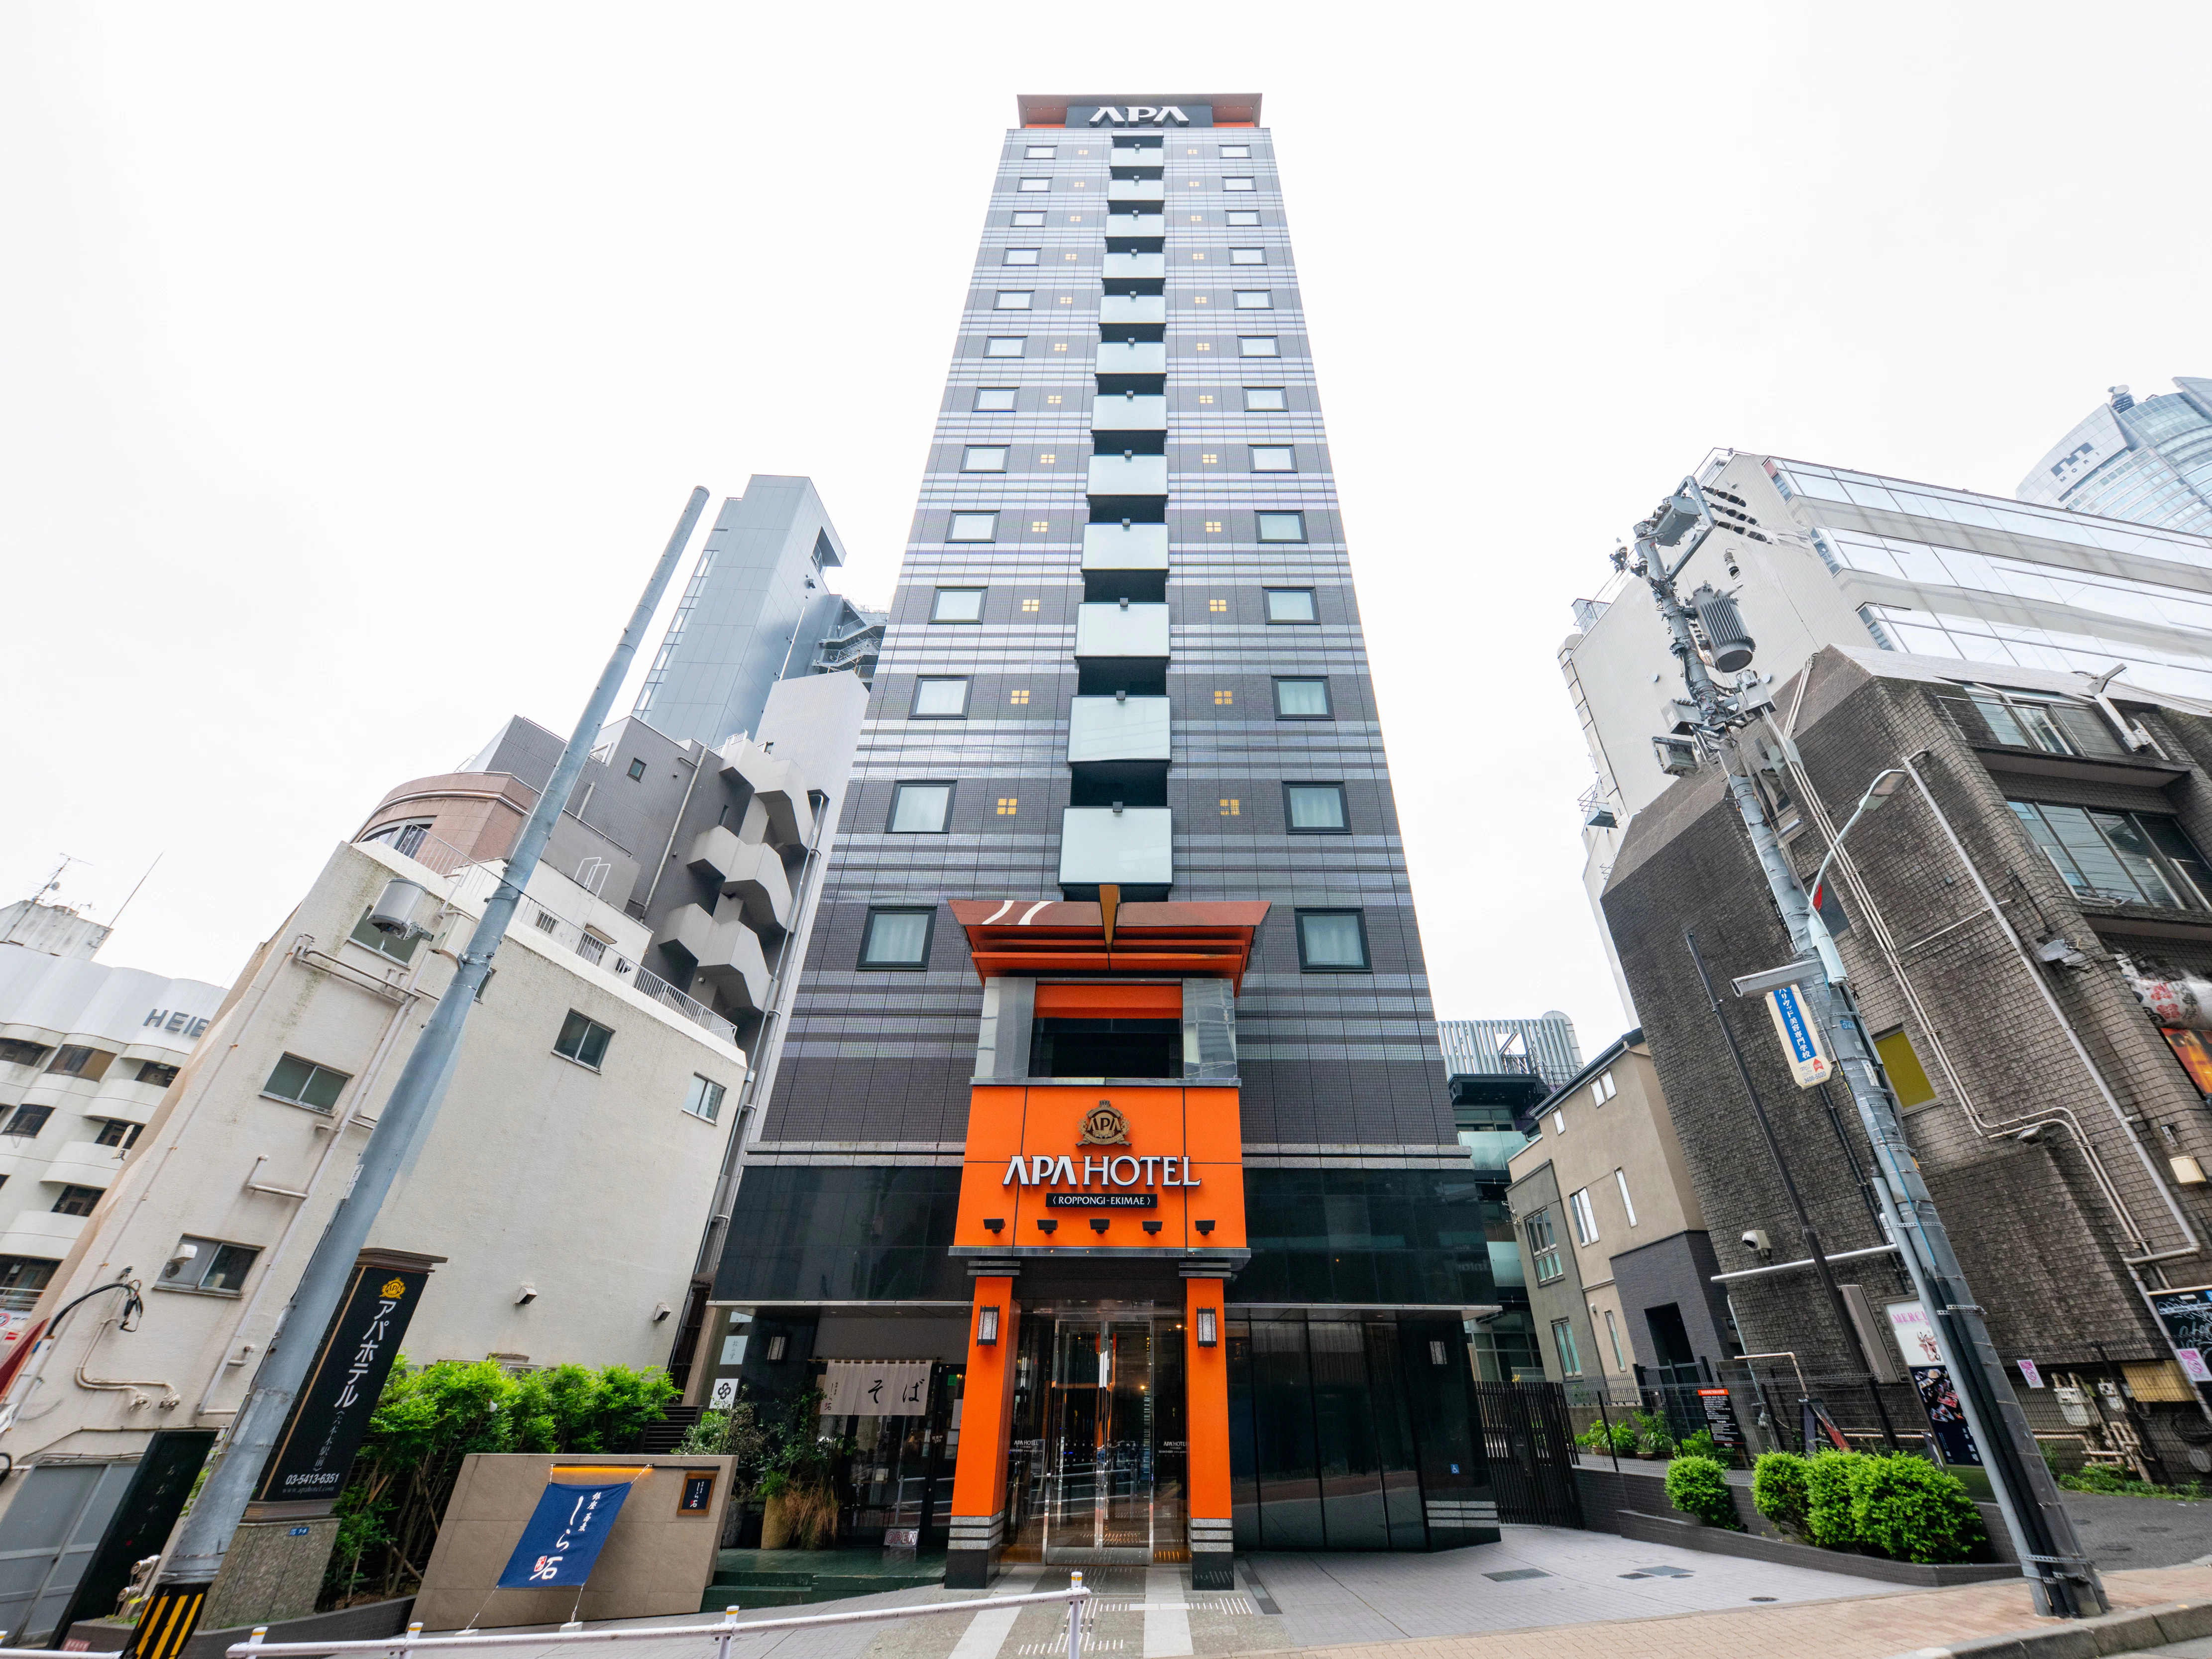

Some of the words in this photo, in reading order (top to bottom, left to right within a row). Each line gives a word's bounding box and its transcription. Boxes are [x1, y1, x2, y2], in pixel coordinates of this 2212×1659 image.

[1089, 106, 1190, 127] APA
[2060, 452, 2100, 482] MORI
[1804, 1071, 1826, 1084] 3408-5020
[1087, 1117, 1121, 1132] APA
[1002, 1155, 1078, 1186] APA
[1082, 1155, 1202, 1186] HOTEL
[334, 1300, 397, 1408] アパホテル
[824, 1383, 833, 1411] しら石
[868, 1379, 925, 1404] そば
[285, 1473, 340, 1485] 03-5413-6351
[690, 1482, 700, 1507] しら石
[529, 1496, 584, 1581] しら石
[886, 1531, 918, 1546] OPEN
